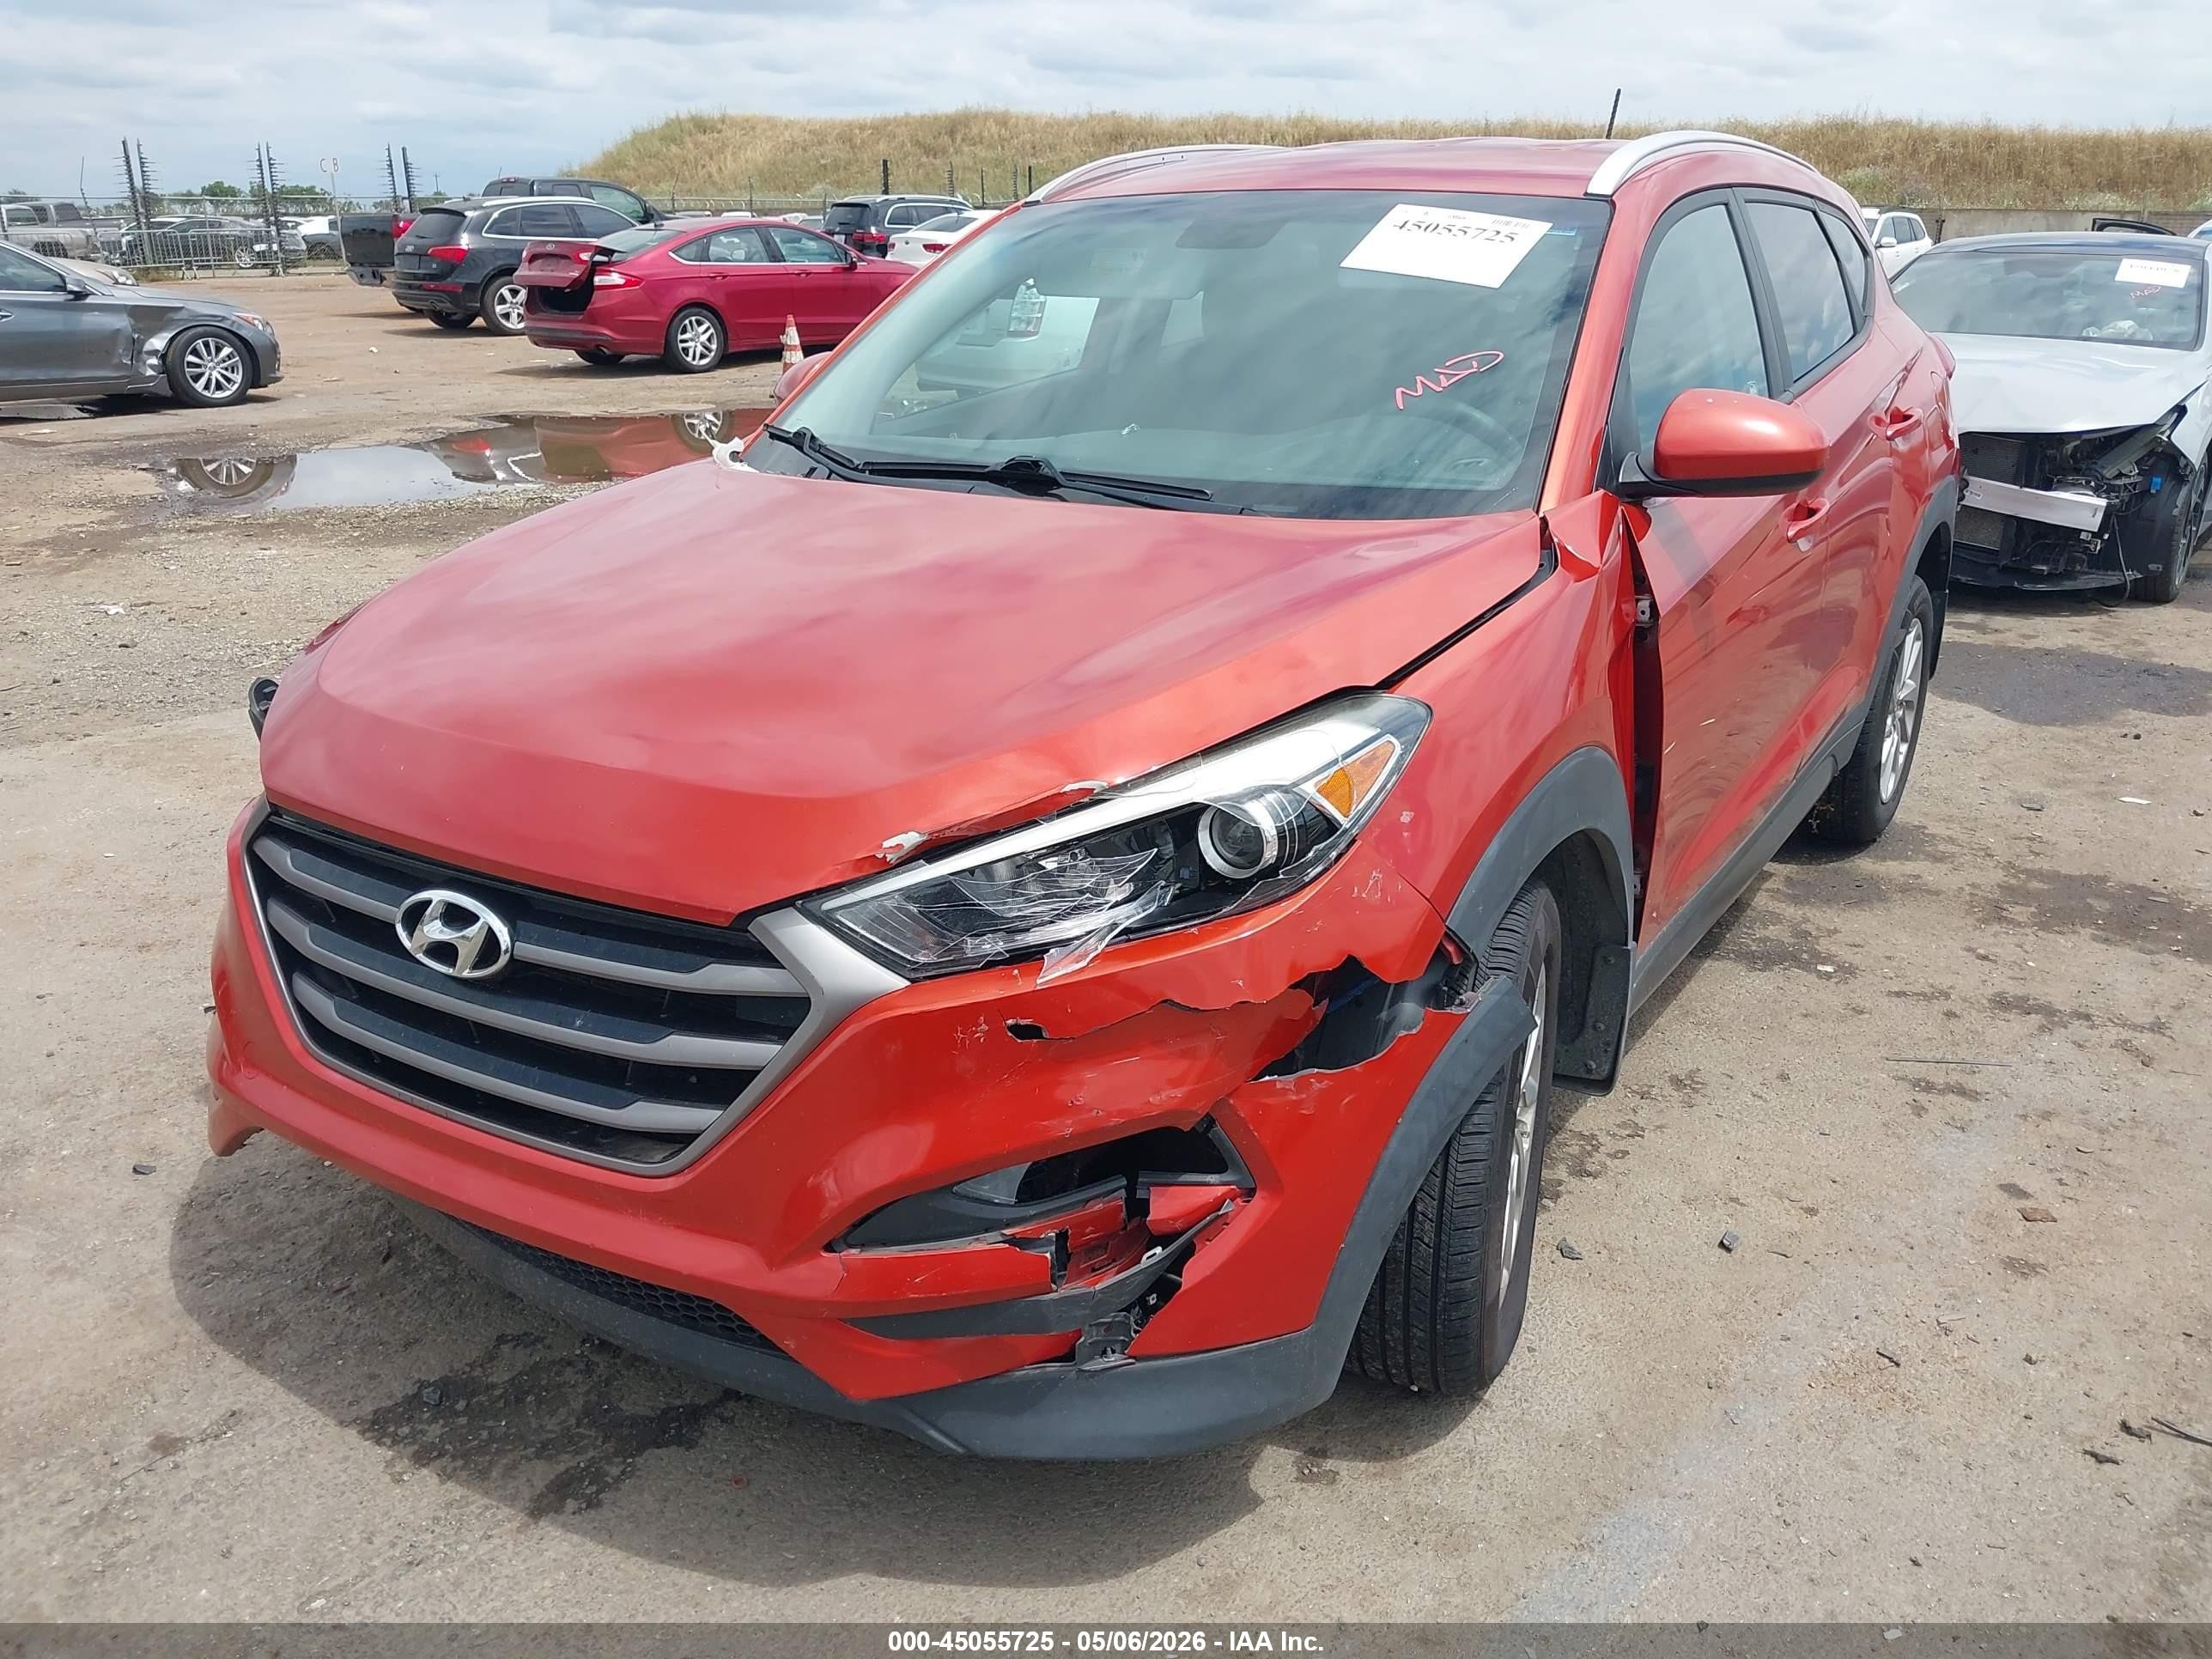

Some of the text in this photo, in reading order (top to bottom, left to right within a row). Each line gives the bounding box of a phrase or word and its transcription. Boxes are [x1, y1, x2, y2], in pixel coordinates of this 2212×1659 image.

[332, 158, 339, 173] B
[1394, 219, 1519, 243] 45055725
[1395, 350, 1504, 410] MAD
